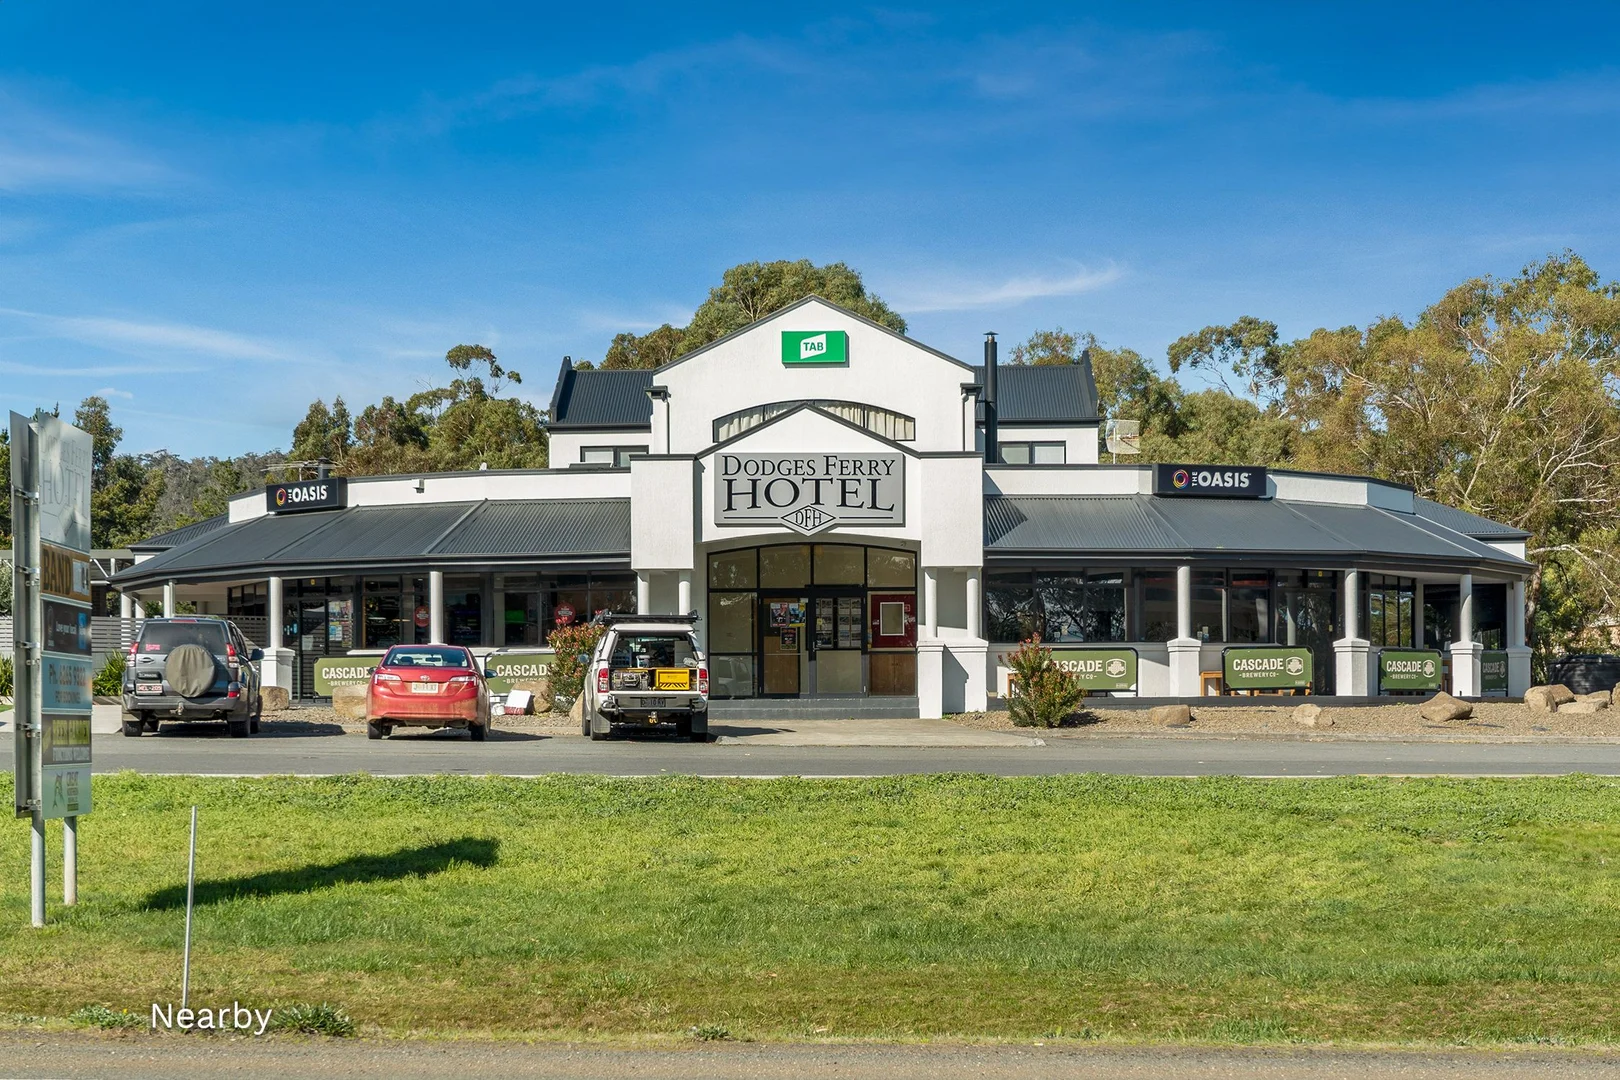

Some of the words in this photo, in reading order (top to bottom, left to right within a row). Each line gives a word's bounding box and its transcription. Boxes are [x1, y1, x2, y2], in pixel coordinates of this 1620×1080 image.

[803, 342, 824, 351] TAB
[722, 455, 815, 476] DODGES
[823, 455, 895, 476] FERRY
[1198, 471, 1250, 488] OASIS
[292, 485, 328, 503] OASIS
[722, 477, 895, 512] HOTEL
[795, 509, 822, 527] DFH
[497, 664, 554, 677] CASCAD
[1233, 658, 1284, 671] CASCADE
[1386, 660, 1422, 673] CASCADE
[1482, 662, 1500, 673] CASCADE
[322, 666, 371, 680] CASCADE
